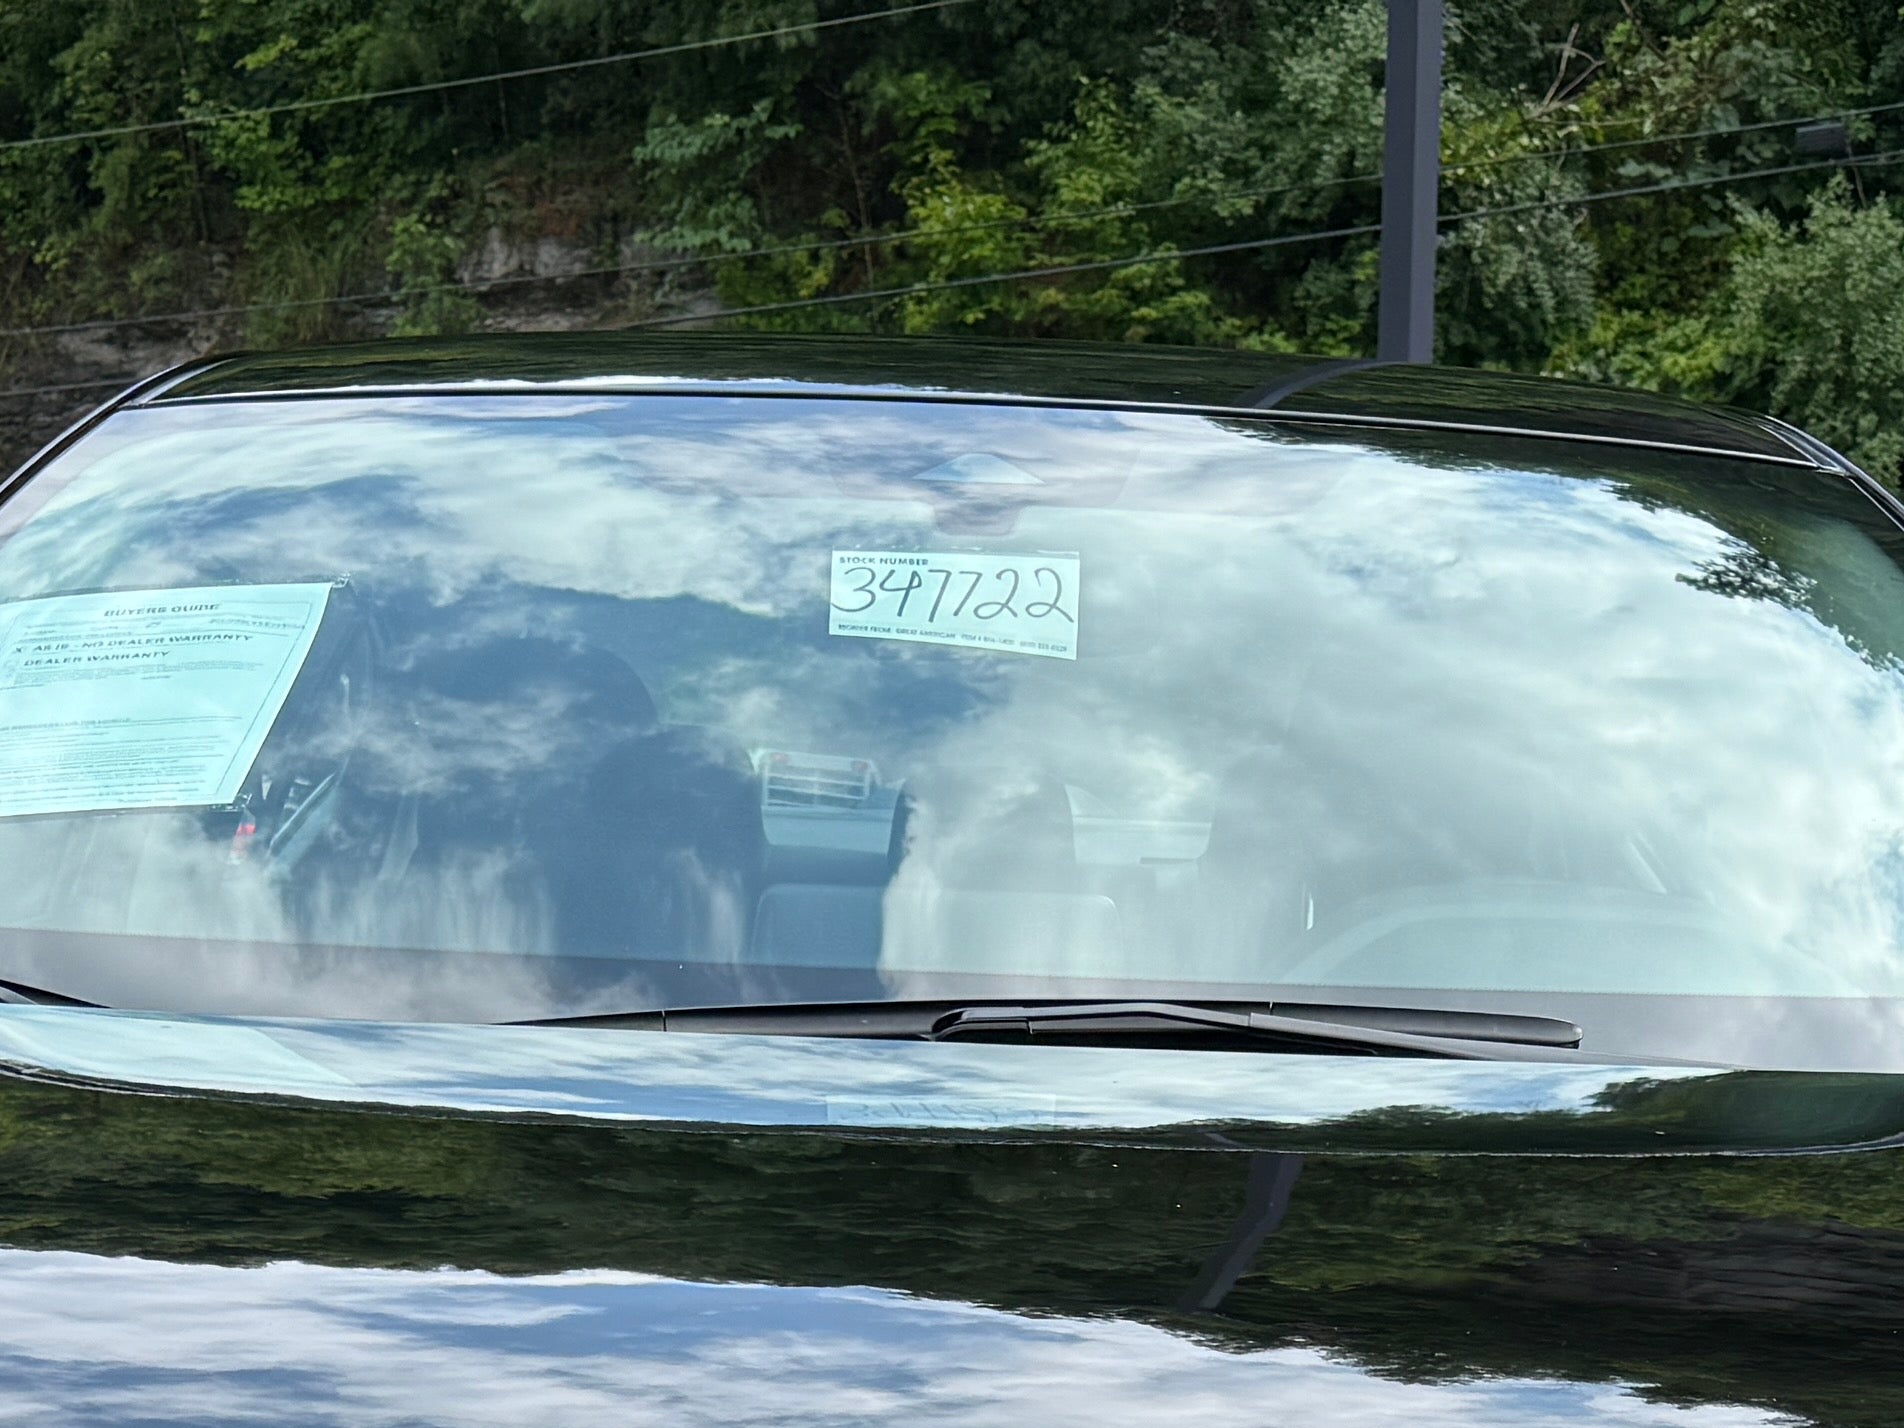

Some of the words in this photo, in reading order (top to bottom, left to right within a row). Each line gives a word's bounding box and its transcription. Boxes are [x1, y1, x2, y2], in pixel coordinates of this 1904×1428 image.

[839, 556, 875, 564] STOCK
[879, 557, 929, 566] NUMBER
[831, 567, 1075, 623] 347722
[82, 640, 104, 649] NO
[107, 637, 165, 647] DEALER
[168, 633, 254, 643] WARRANTY
[23, 656, 83, 667] DEALER
[86, 650, 171, 662] WARRANTY
